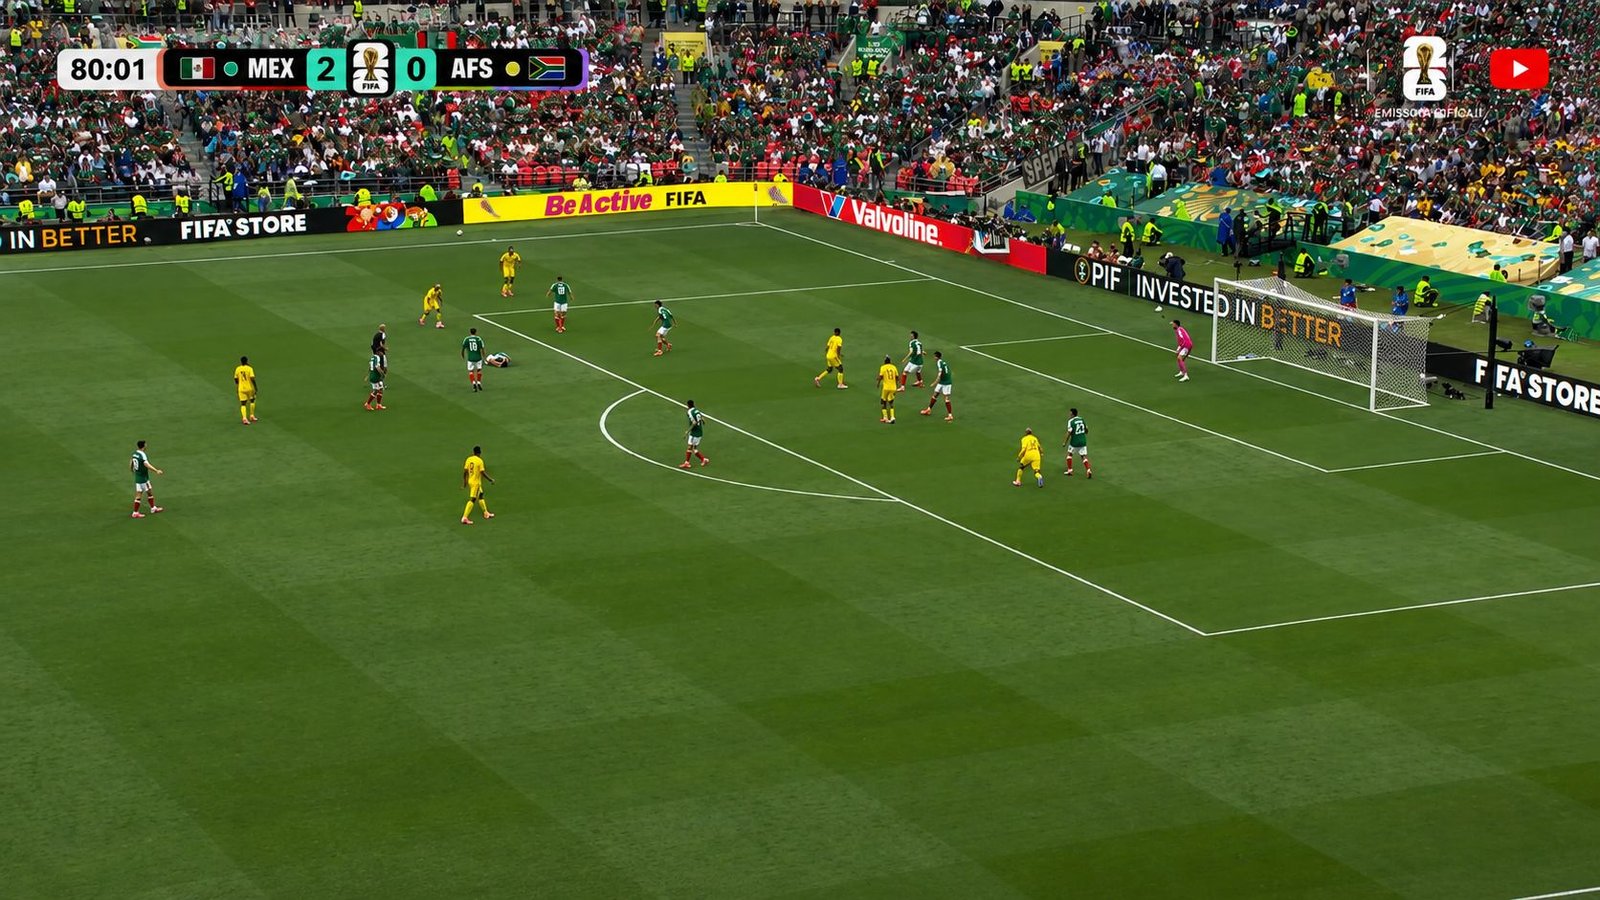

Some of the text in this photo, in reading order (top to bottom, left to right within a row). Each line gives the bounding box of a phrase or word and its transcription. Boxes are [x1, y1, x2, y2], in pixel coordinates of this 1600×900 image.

[544, 190, 652, 216] Be Active
[666, 191, 707, 206] FIFA
[10, 224, 137, 249] IN BETTER
[181, 214, 307, 240] FIFA STORE
[1092, 262, 1122, 291] PIF
[1136, 274, 1230, 318] INVESTED
[1235, 298, 1256, 325] IN
[1475, 358, 1600, 415] FFA STORE
